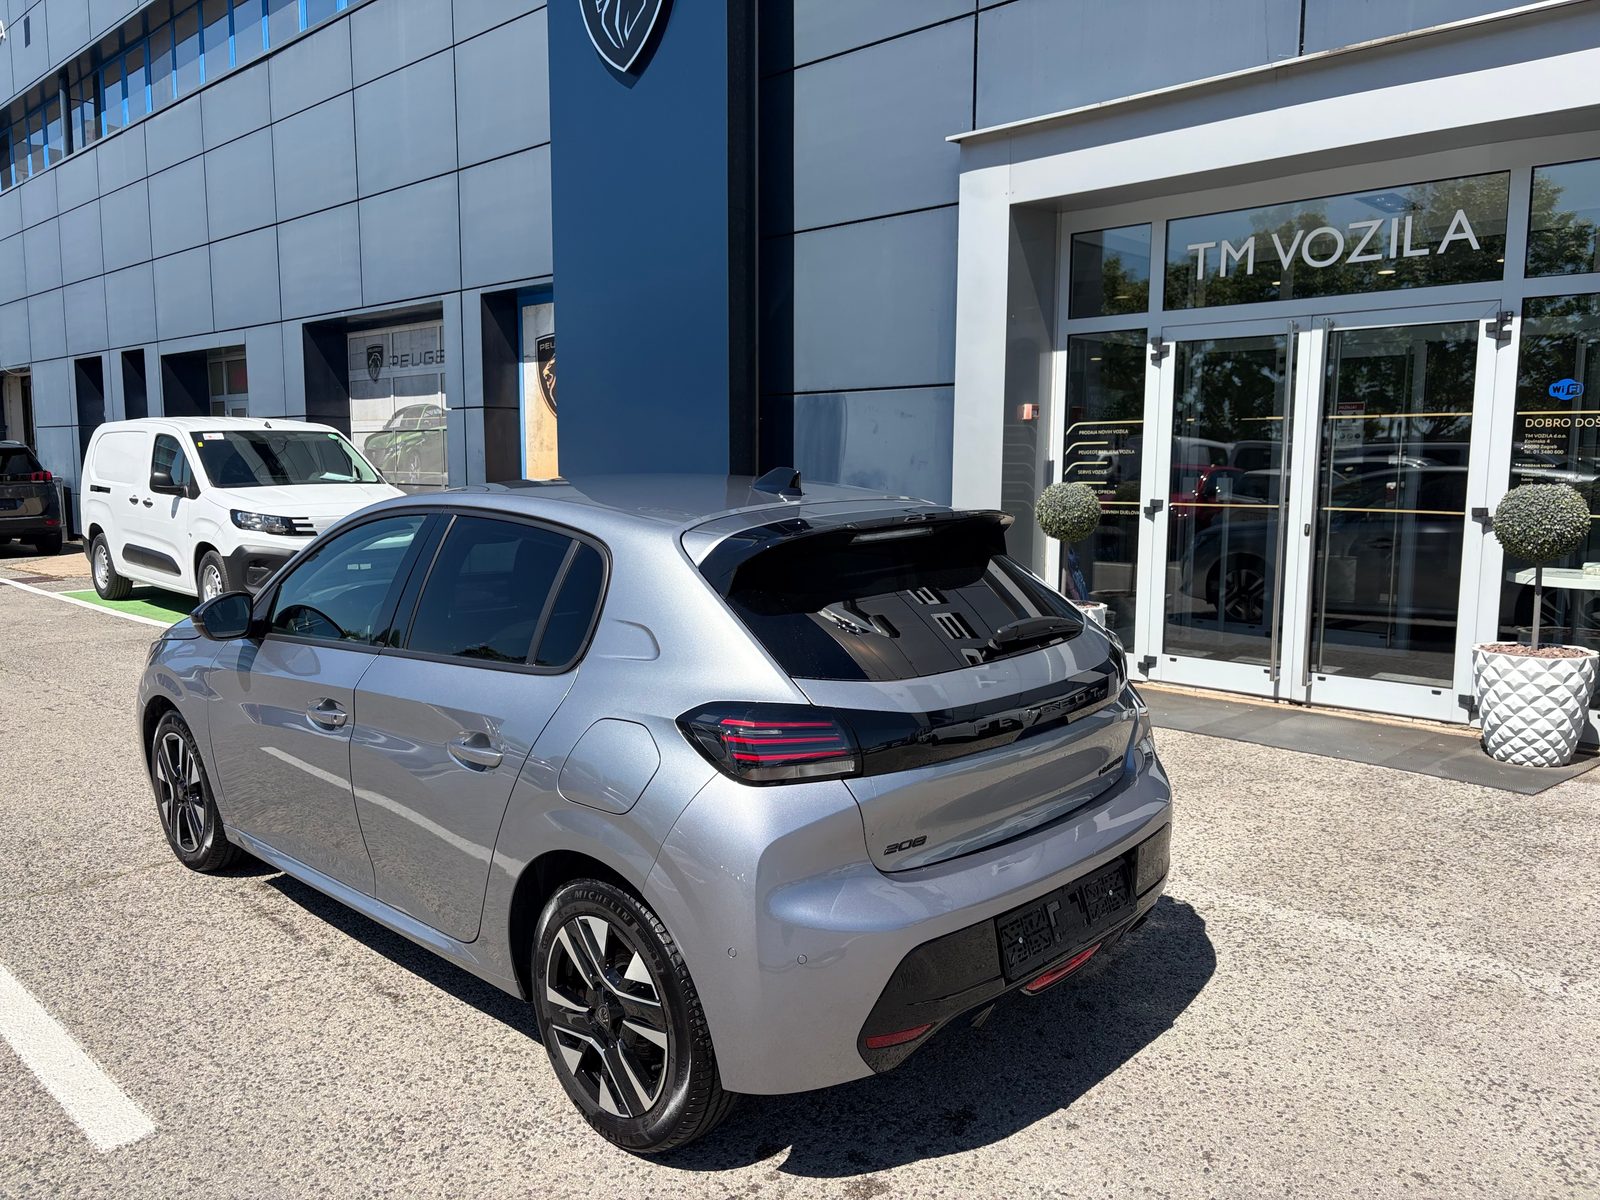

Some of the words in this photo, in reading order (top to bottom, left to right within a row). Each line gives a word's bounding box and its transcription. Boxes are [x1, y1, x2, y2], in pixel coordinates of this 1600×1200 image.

[1187, 236, 1255, 281] TM
[1272, 208, 1480, 271] VOZILA
[1525, 418, 1571, 428] DOBRO
[883, 835, 928, 856] 208
[574, 890, 630, 921] MICHELIN
